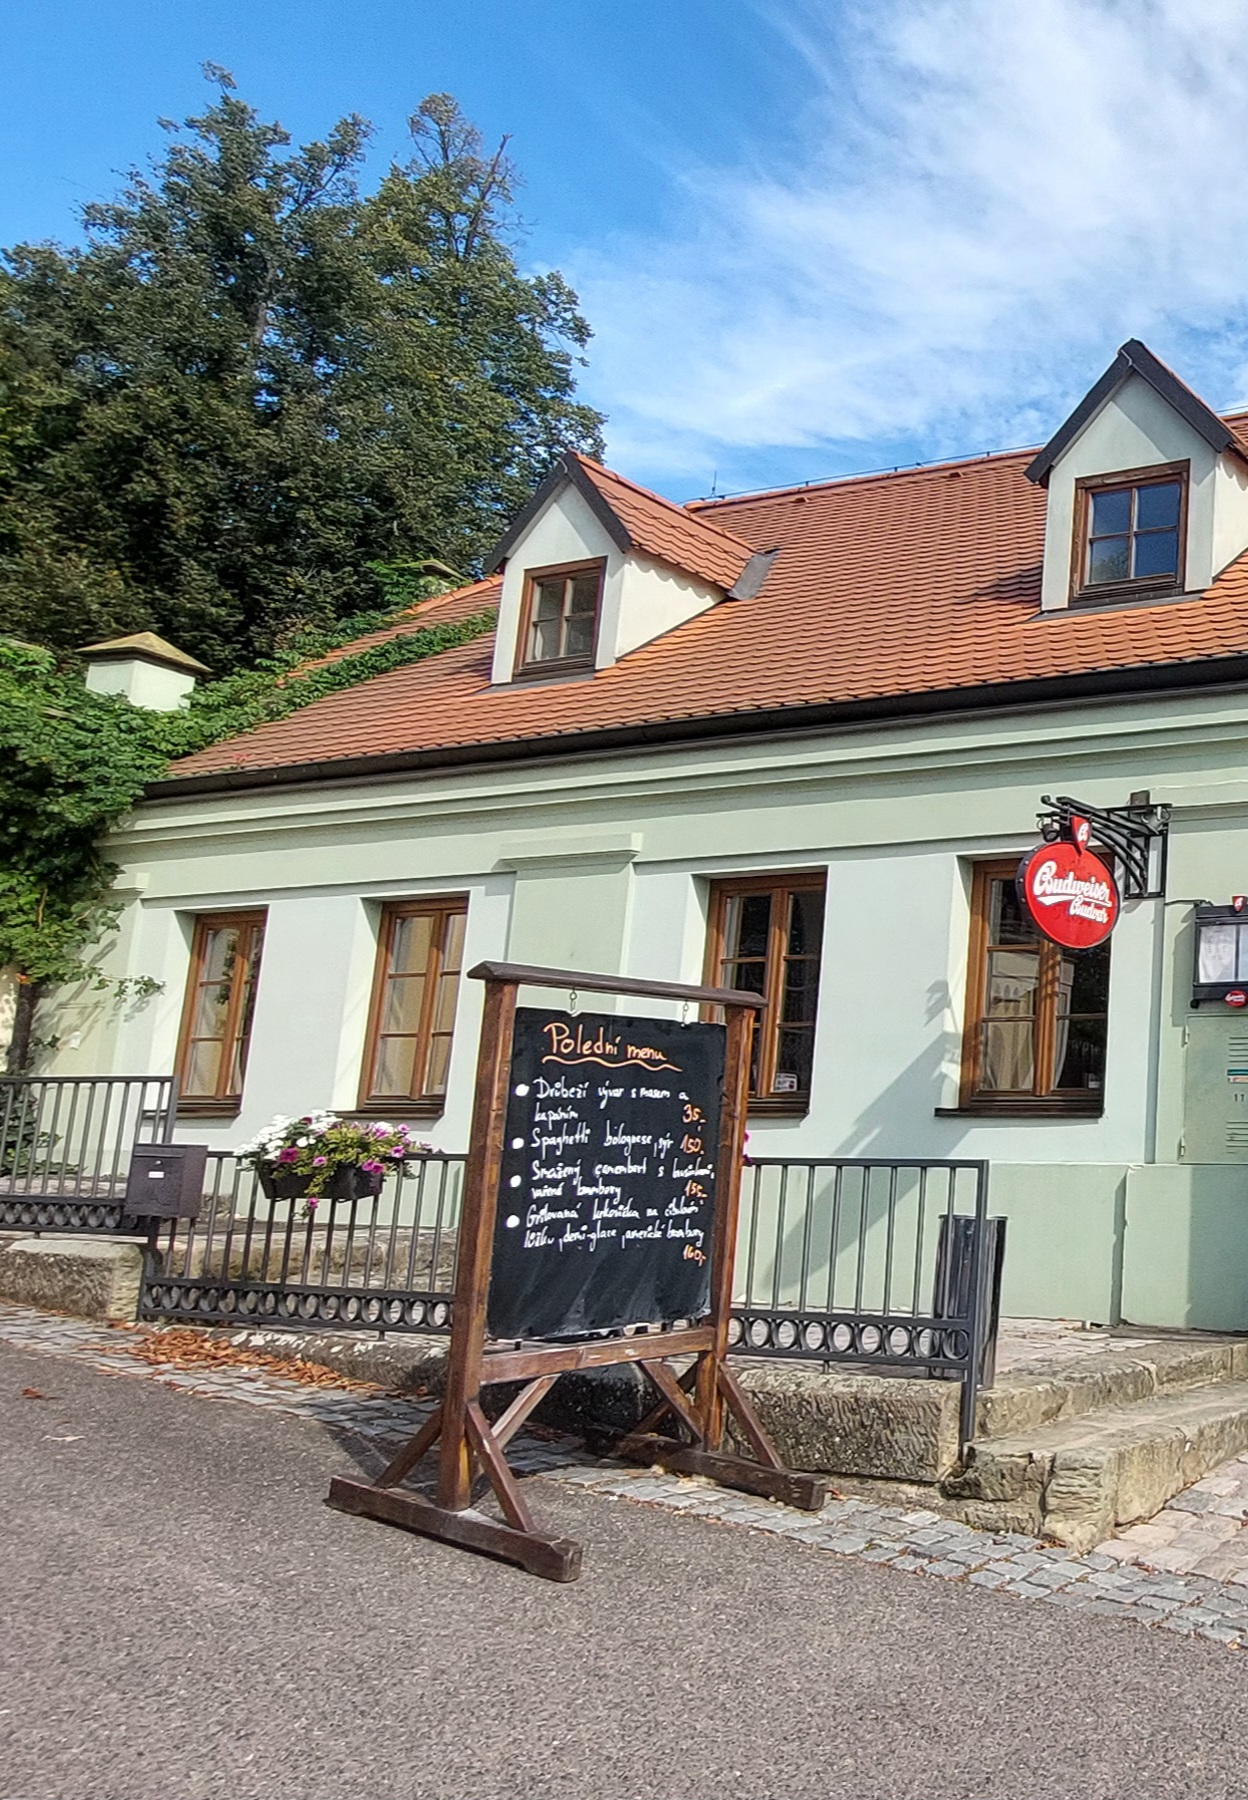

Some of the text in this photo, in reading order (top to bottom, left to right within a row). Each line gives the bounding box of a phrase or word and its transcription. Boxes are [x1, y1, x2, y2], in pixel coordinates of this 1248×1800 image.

[1033, 860, 1112, 907] Budweiser
[1070, 895, 1108, 923] Budvar
[543, 1022, 668, 1062] Polední menu
[532, 1075, 690, 1110] Drůbeží vývar s masem a
[1233, 1093, 1246, 1103] 11
[530, 1121, 592, 1160] Spaghetti
[531, 1159, 583, 1186] Smažený
[657, 1165, 665, 1178] s
